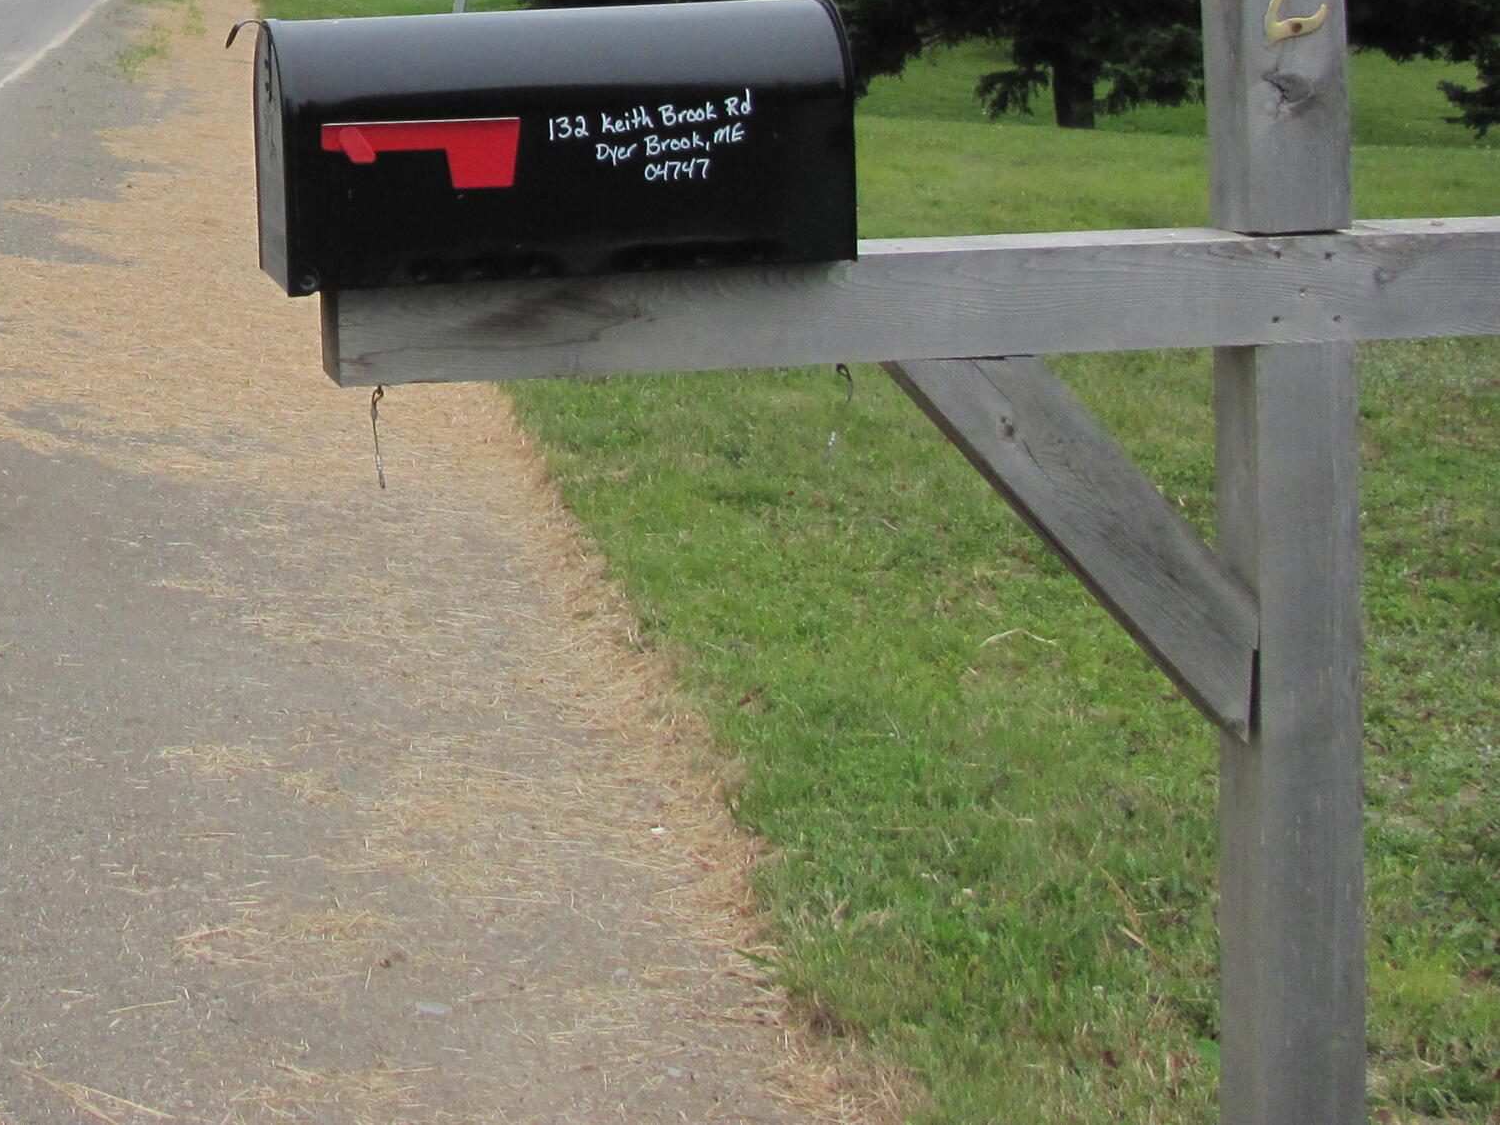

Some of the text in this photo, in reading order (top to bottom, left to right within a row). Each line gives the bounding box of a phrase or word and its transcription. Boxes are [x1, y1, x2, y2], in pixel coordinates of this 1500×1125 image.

[549, 115, 589, 141] 132
[658, 102, 718, 127] Brook
[724, 88, 752, 116] Rd
[595, 123, 745, 166] Dyer Brook, ME
[644, 158, 710, 182] 04747
